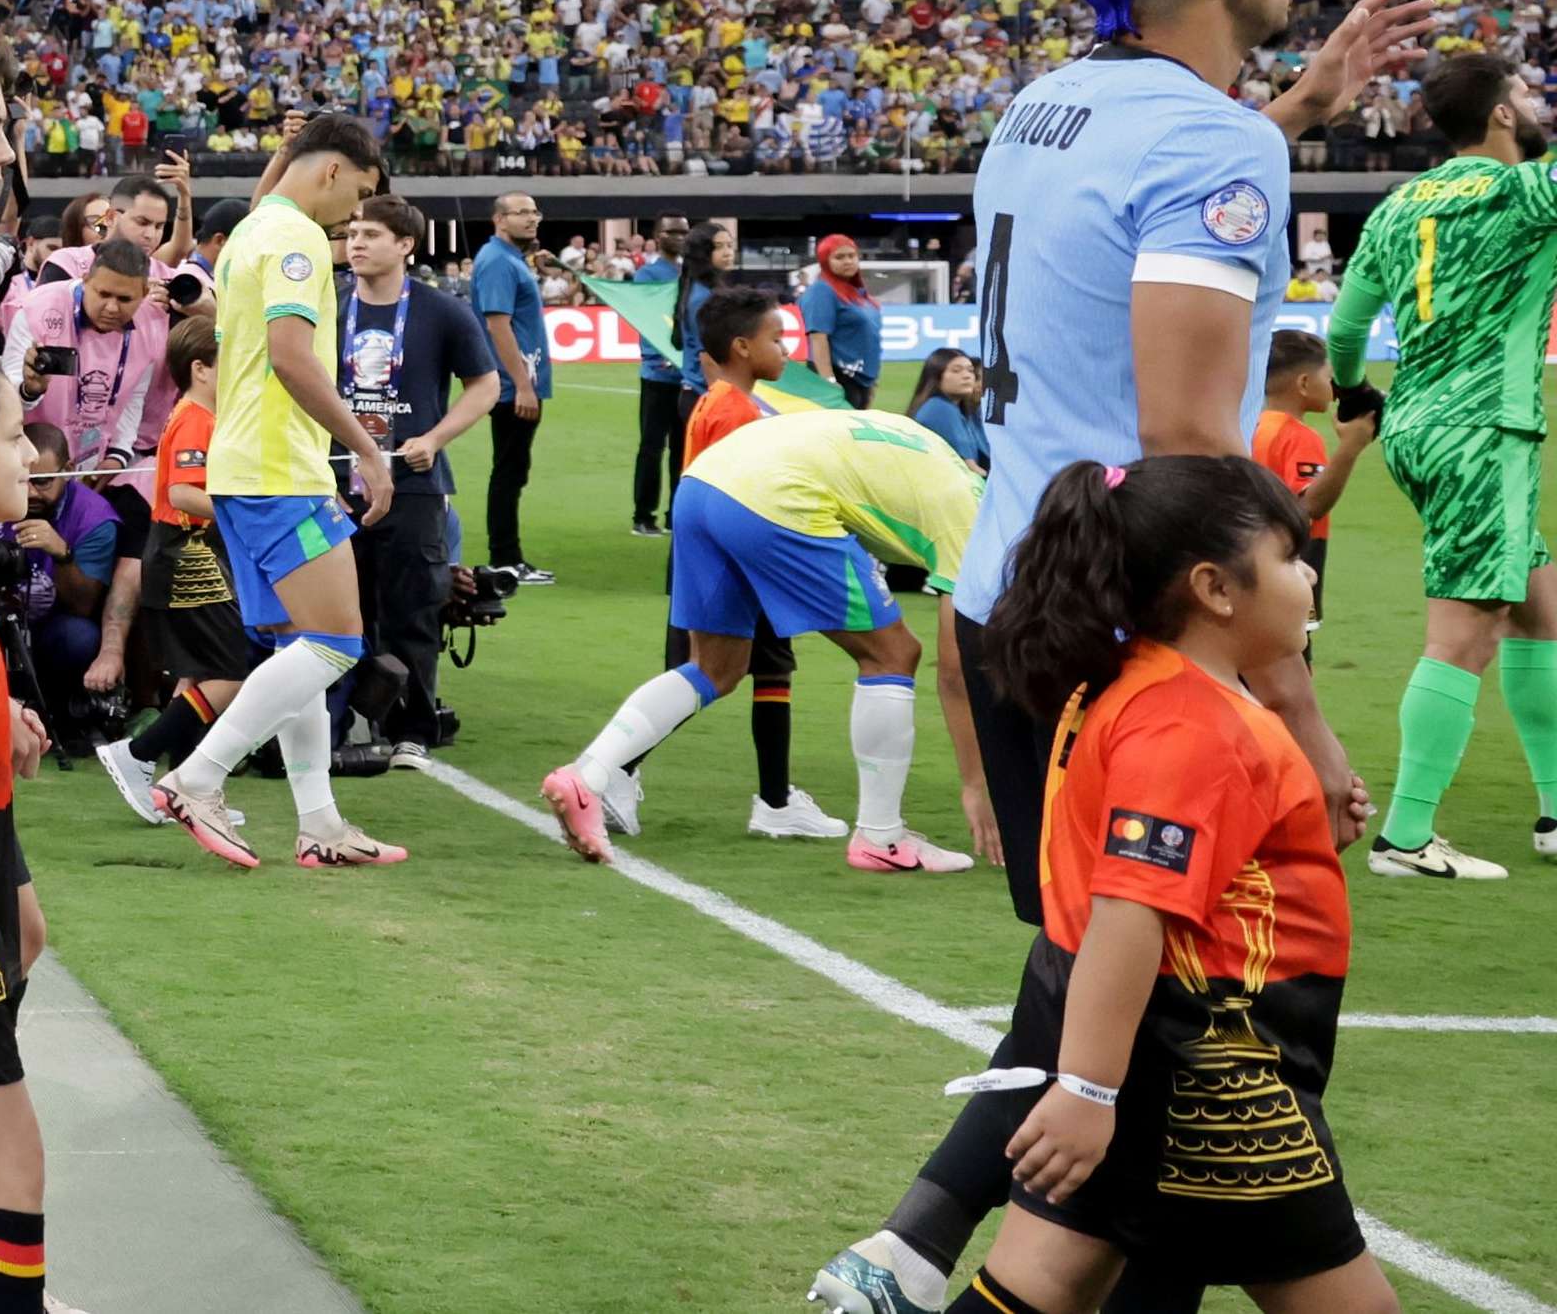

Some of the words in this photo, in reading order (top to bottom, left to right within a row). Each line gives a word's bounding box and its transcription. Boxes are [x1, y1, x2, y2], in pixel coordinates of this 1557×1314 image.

[499, 155, 525, 169] 144
[1416, 216, 1437, 323] 1
[983, 212, 1020, 426] 4
[356, 401, 413, 414] AMERICA
